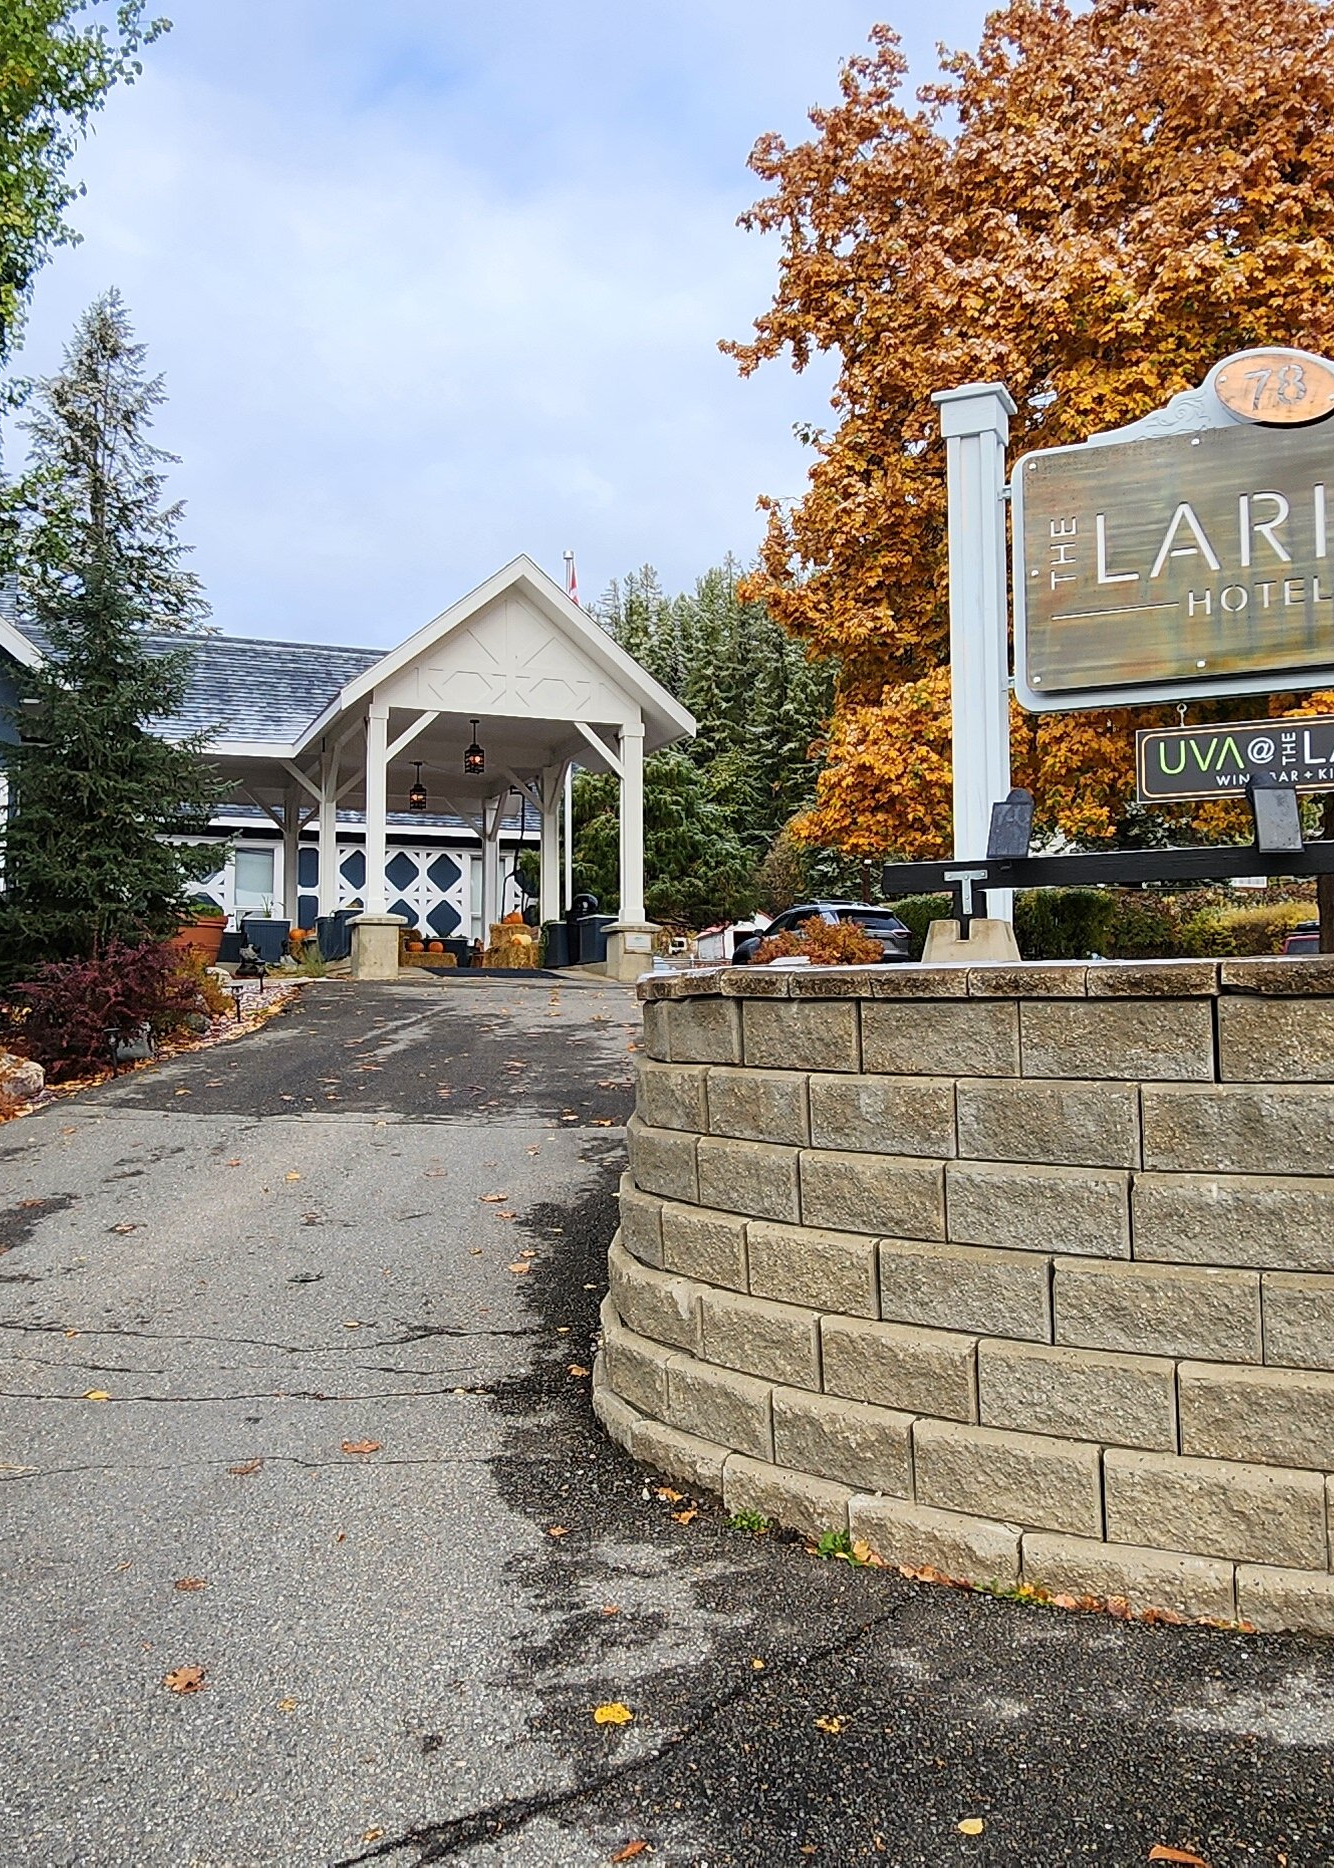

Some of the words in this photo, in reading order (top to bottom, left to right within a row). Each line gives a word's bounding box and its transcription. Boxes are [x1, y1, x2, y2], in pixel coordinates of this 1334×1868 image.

[1244, 364, 1306, 410] 78
[1051, 516, 1077, 590] THE
[1188, 577, 1332, 617] HOTEL
[1281, 732, 1296, 765] THE
[1216, 774, 1253, 786] WIN
